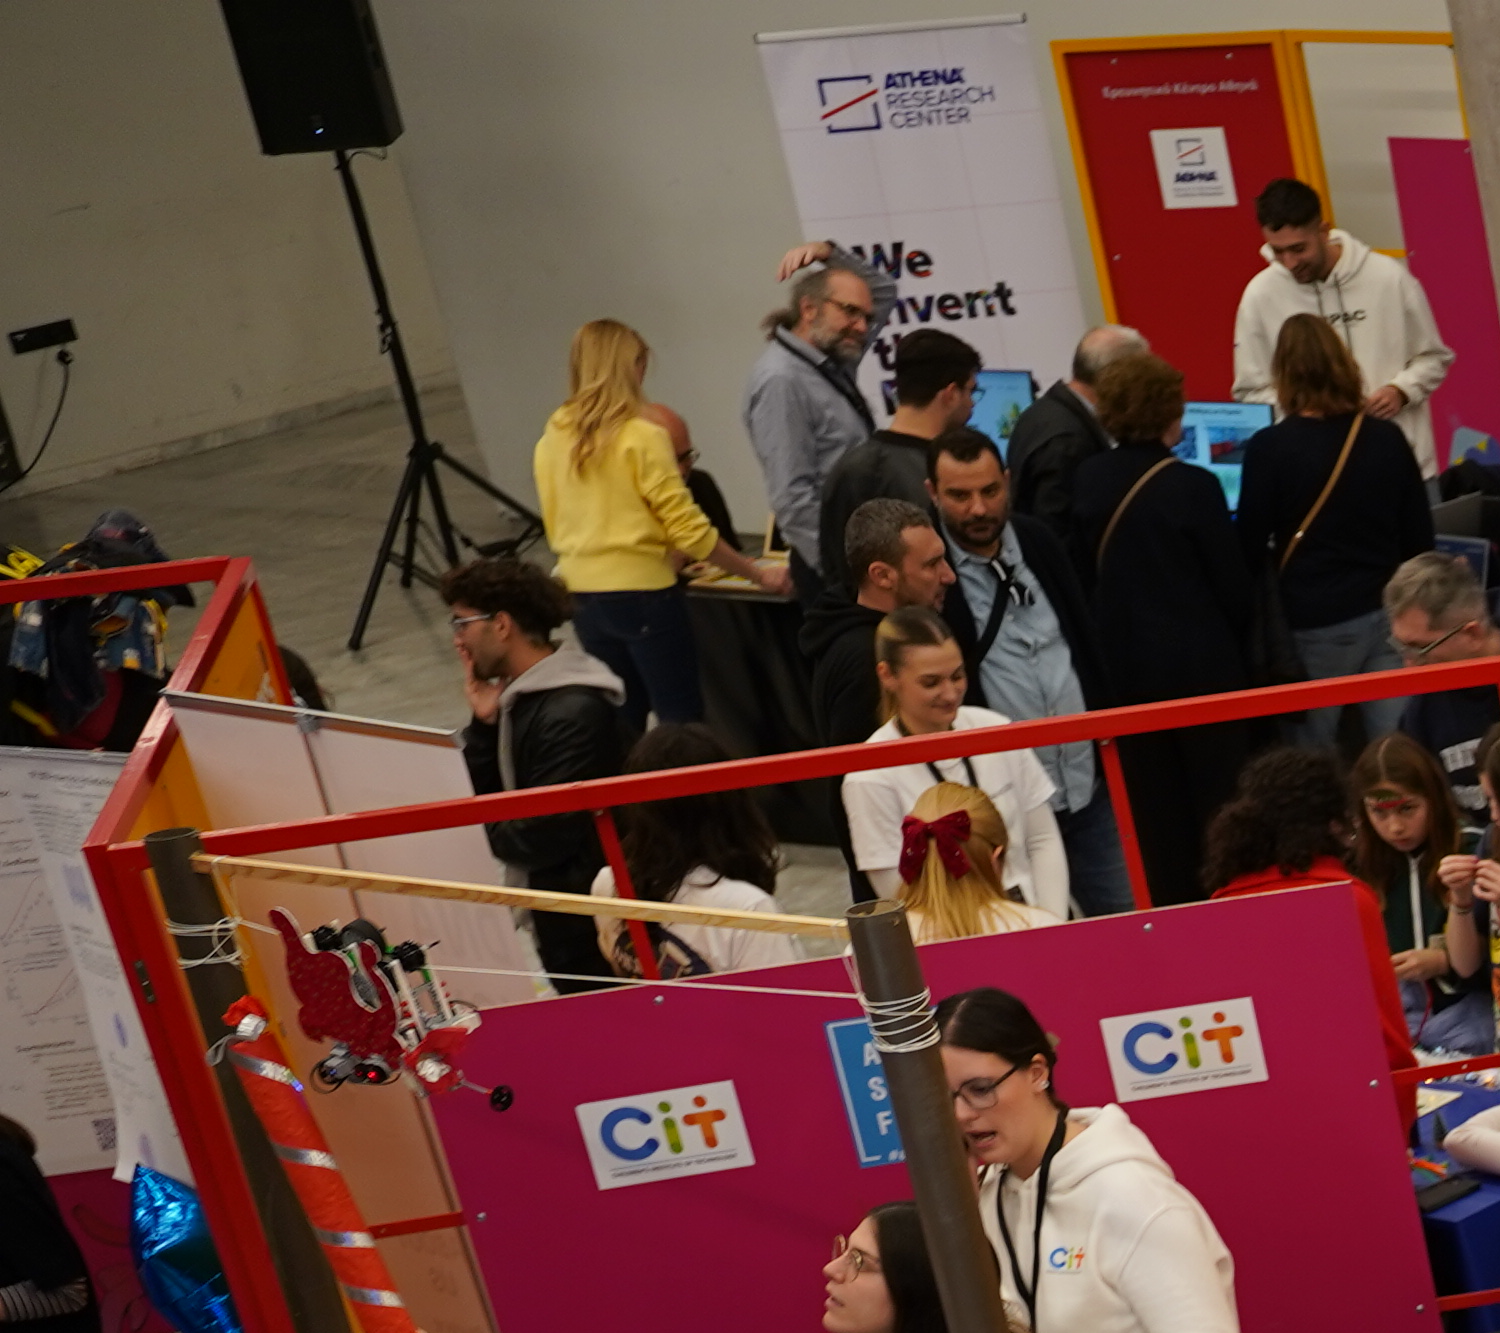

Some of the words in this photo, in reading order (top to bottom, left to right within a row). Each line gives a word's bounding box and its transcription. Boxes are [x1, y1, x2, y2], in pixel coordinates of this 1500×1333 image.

[884, 66, 966, 90] ATHENA
[885, 86, 996, 111] RESEARCH
[889, 107, 972, 130] CENTER
[886, 281, 1018, 326] nvent
